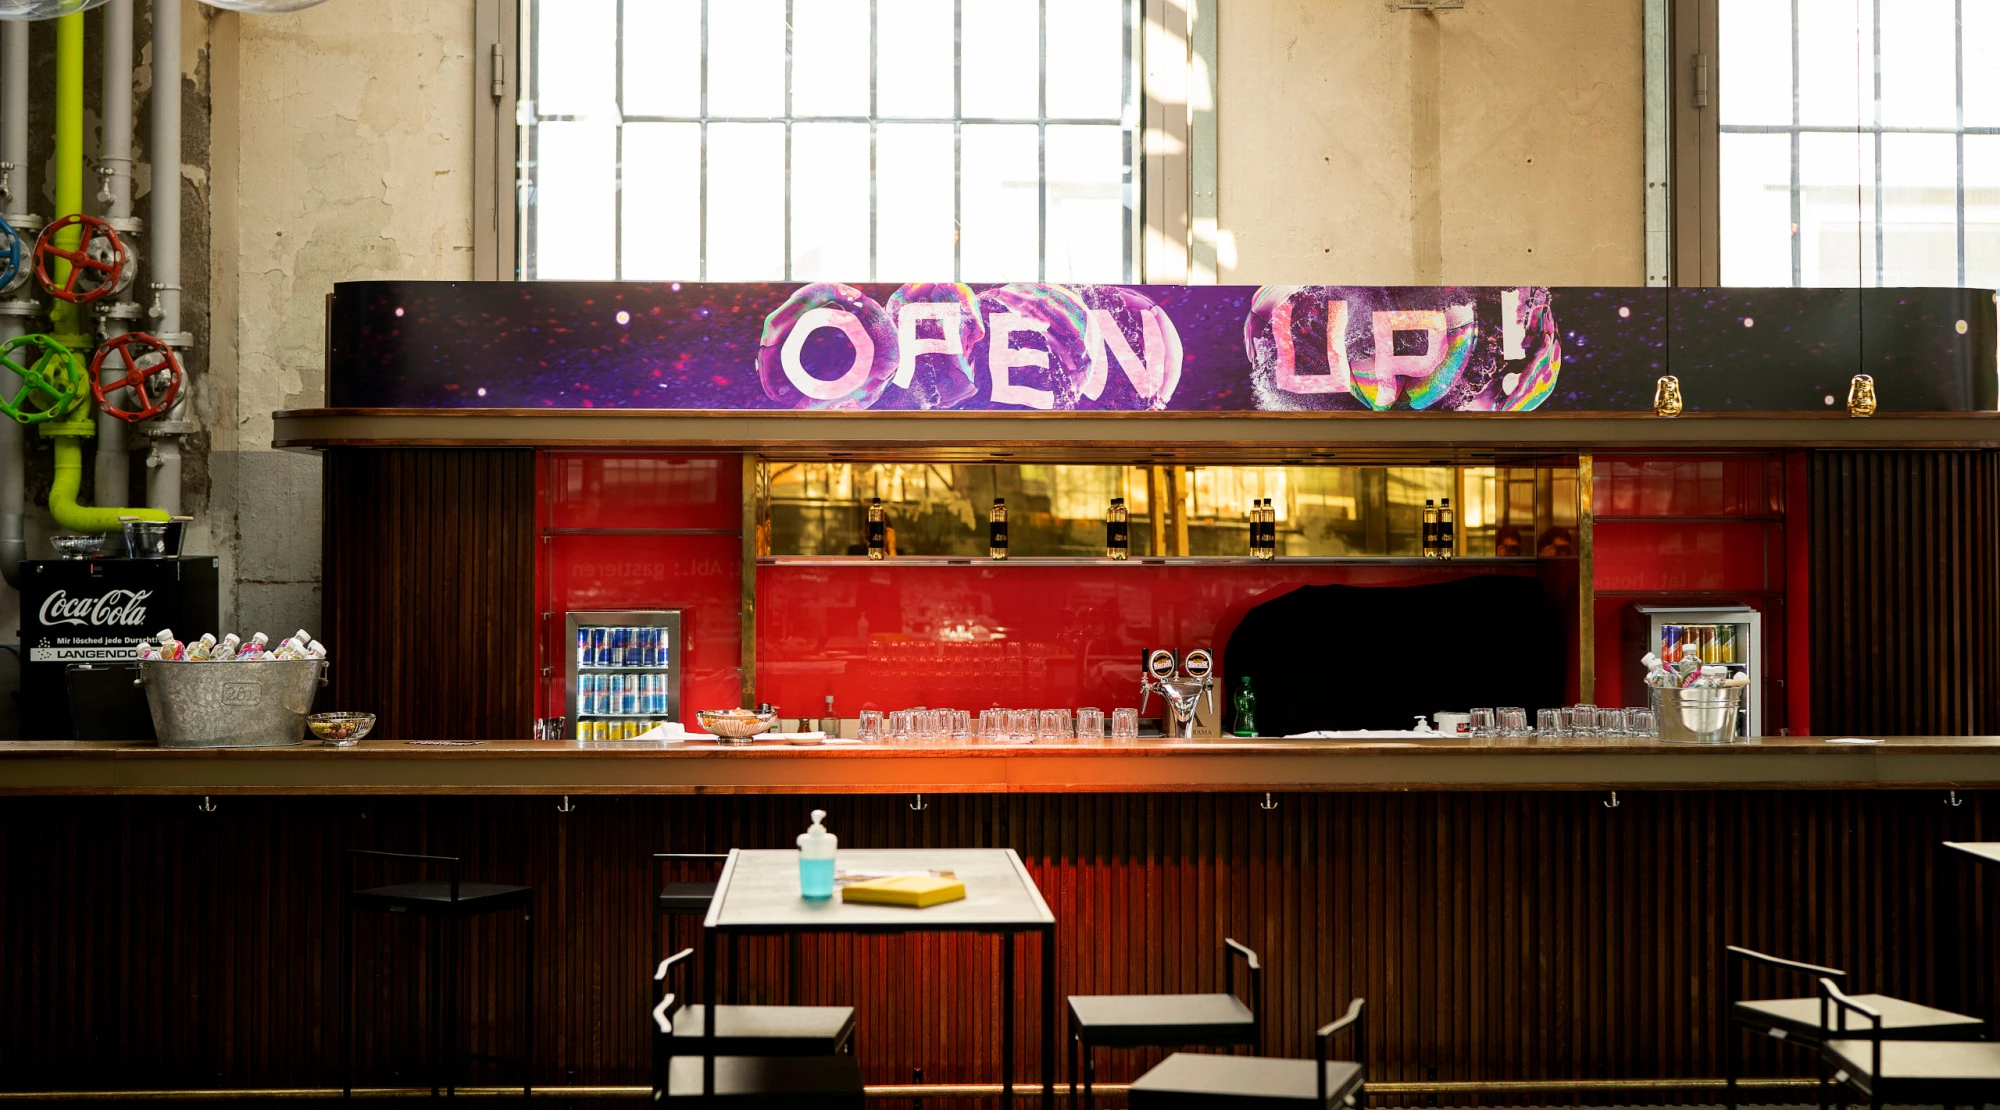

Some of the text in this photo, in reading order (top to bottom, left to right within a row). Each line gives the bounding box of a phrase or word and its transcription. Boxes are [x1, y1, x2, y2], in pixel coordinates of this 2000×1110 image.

[780, 302, 1168, 409] OPEN
[39, 590, 153, 625] Coca-Cola
[105, 637, 122, 645] jede
[57, 650, 157, 659] LANGENDO
